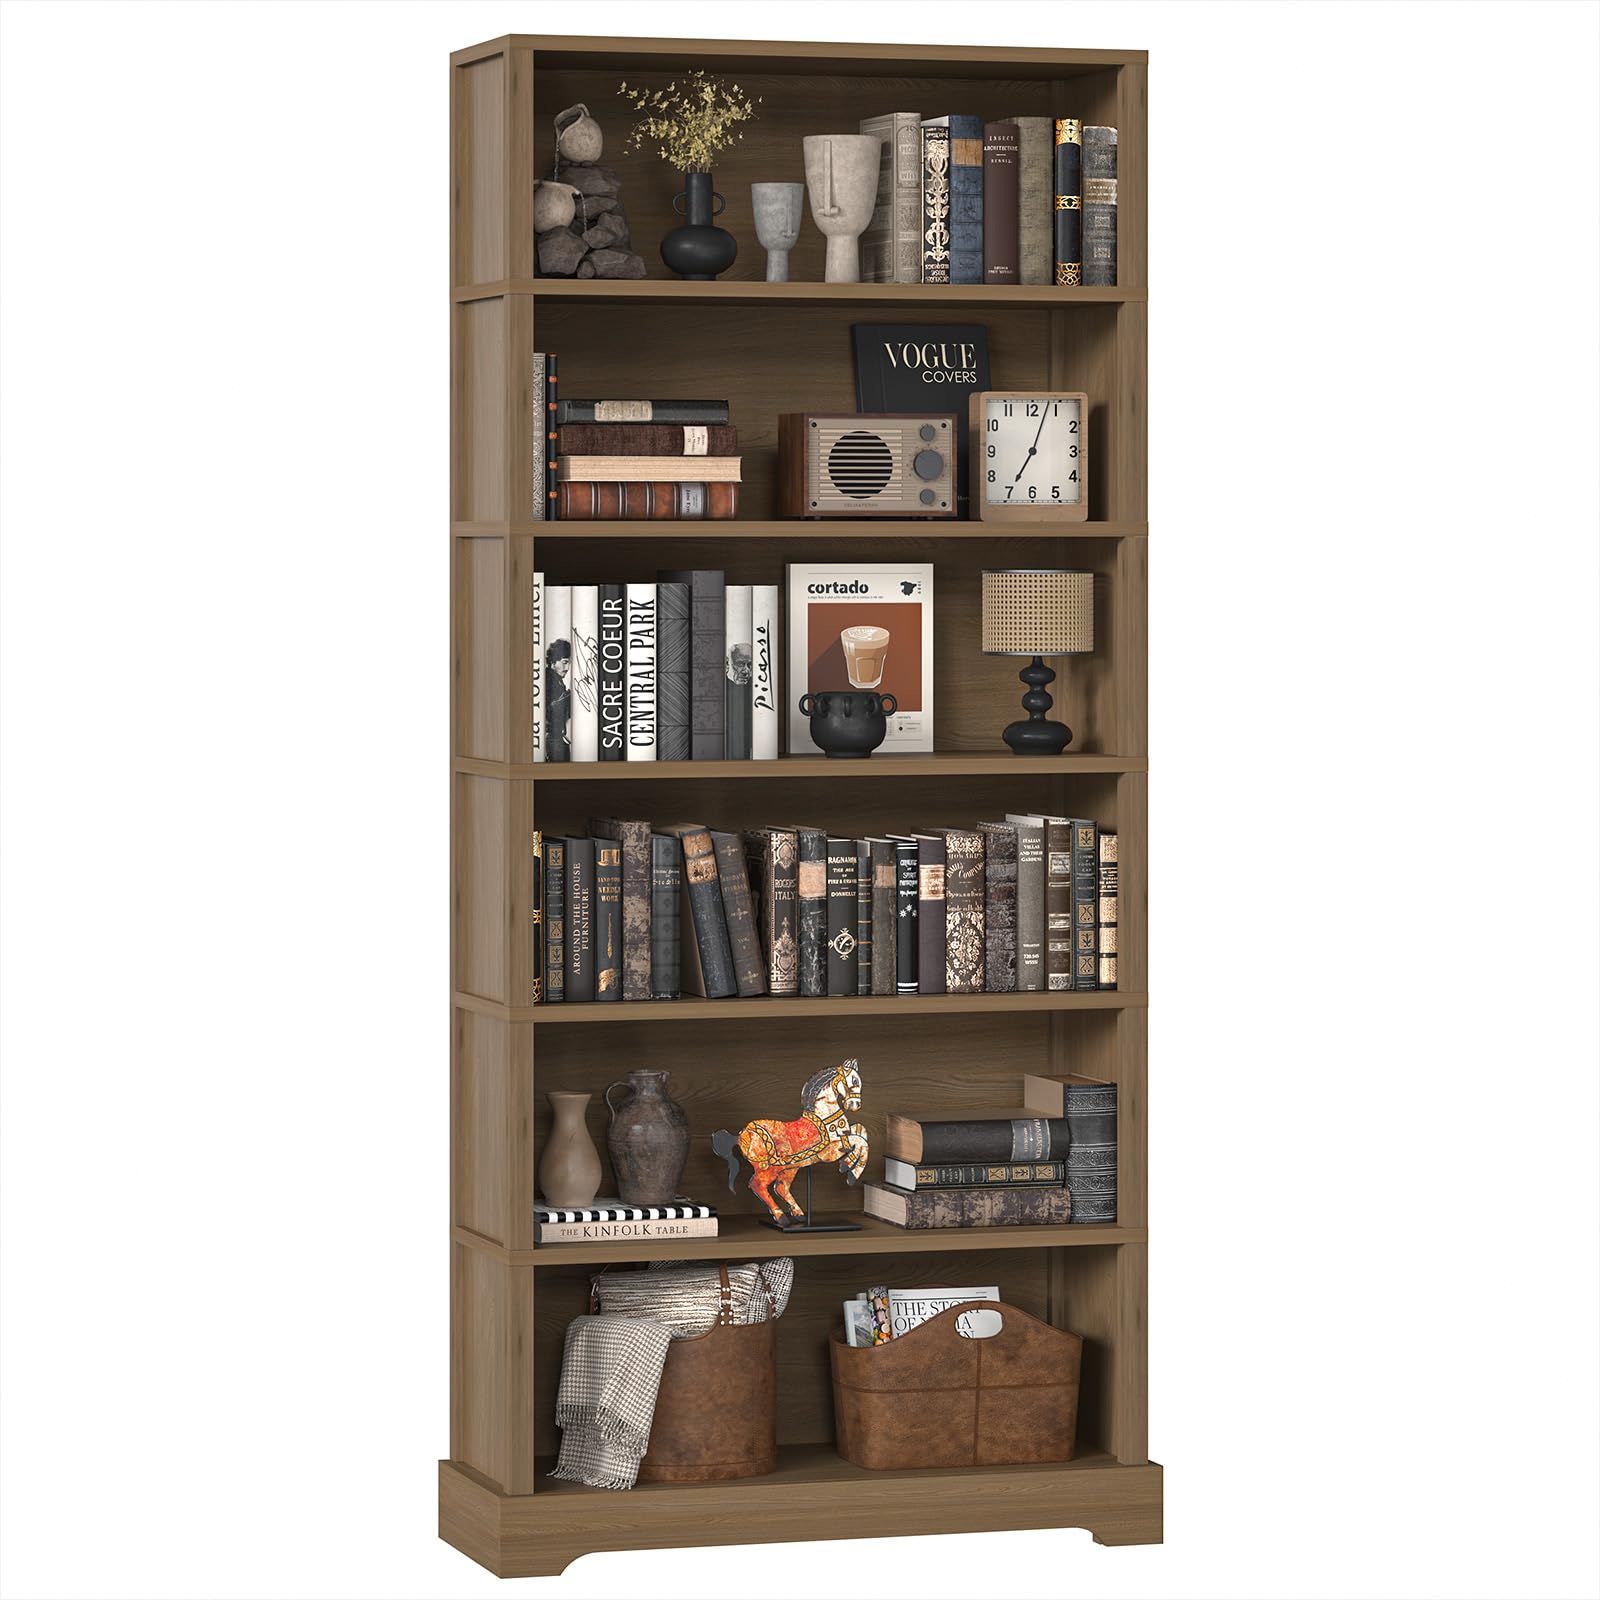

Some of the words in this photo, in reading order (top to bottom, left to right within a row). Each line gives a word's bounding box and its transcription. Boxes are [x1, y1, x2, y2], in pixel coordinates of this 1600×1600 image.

[884, 342, 977, 369] VOGUE
[922, 371, 977, 383] COVERS
[1004, 404, 1012, 416] 11
[1026, 404, 1039, 416] 12
[987, 419, 998, 432] 10
[1069, 421, 1078, 433] 2
[987, 445, 996, 458] 9
[1069, 445, 1078, 458] 3
[987, 469, 996, 482] 8
[1069, 469, 1077, 482] 4
[1005, 486, 1014, 499] 7
[1028, 486, 1037, 499] 6
[1051, 486, 1060, 499] 5
[807, 580, 869, 594] cortado
[629, 599, 654, 646] PARK
[602, 598, 623, 674] COEUR
[629, 655, 654, 747] CENTRAL
[602, 680, 623, 749] SACRE
[573, 862, 581, 899] HOUSE
[774, 891, 795, 901] ITALY
[573, 901, 581, 926] THE
[573, 929, 581, 975] AROUND
[560, 1228, 579, 1237] THE
[583, 1223, 652, 1238] KINFOLK
[656, 1224, 689, 1235] TABLE
[893, 1302, 926, 1317] THE
